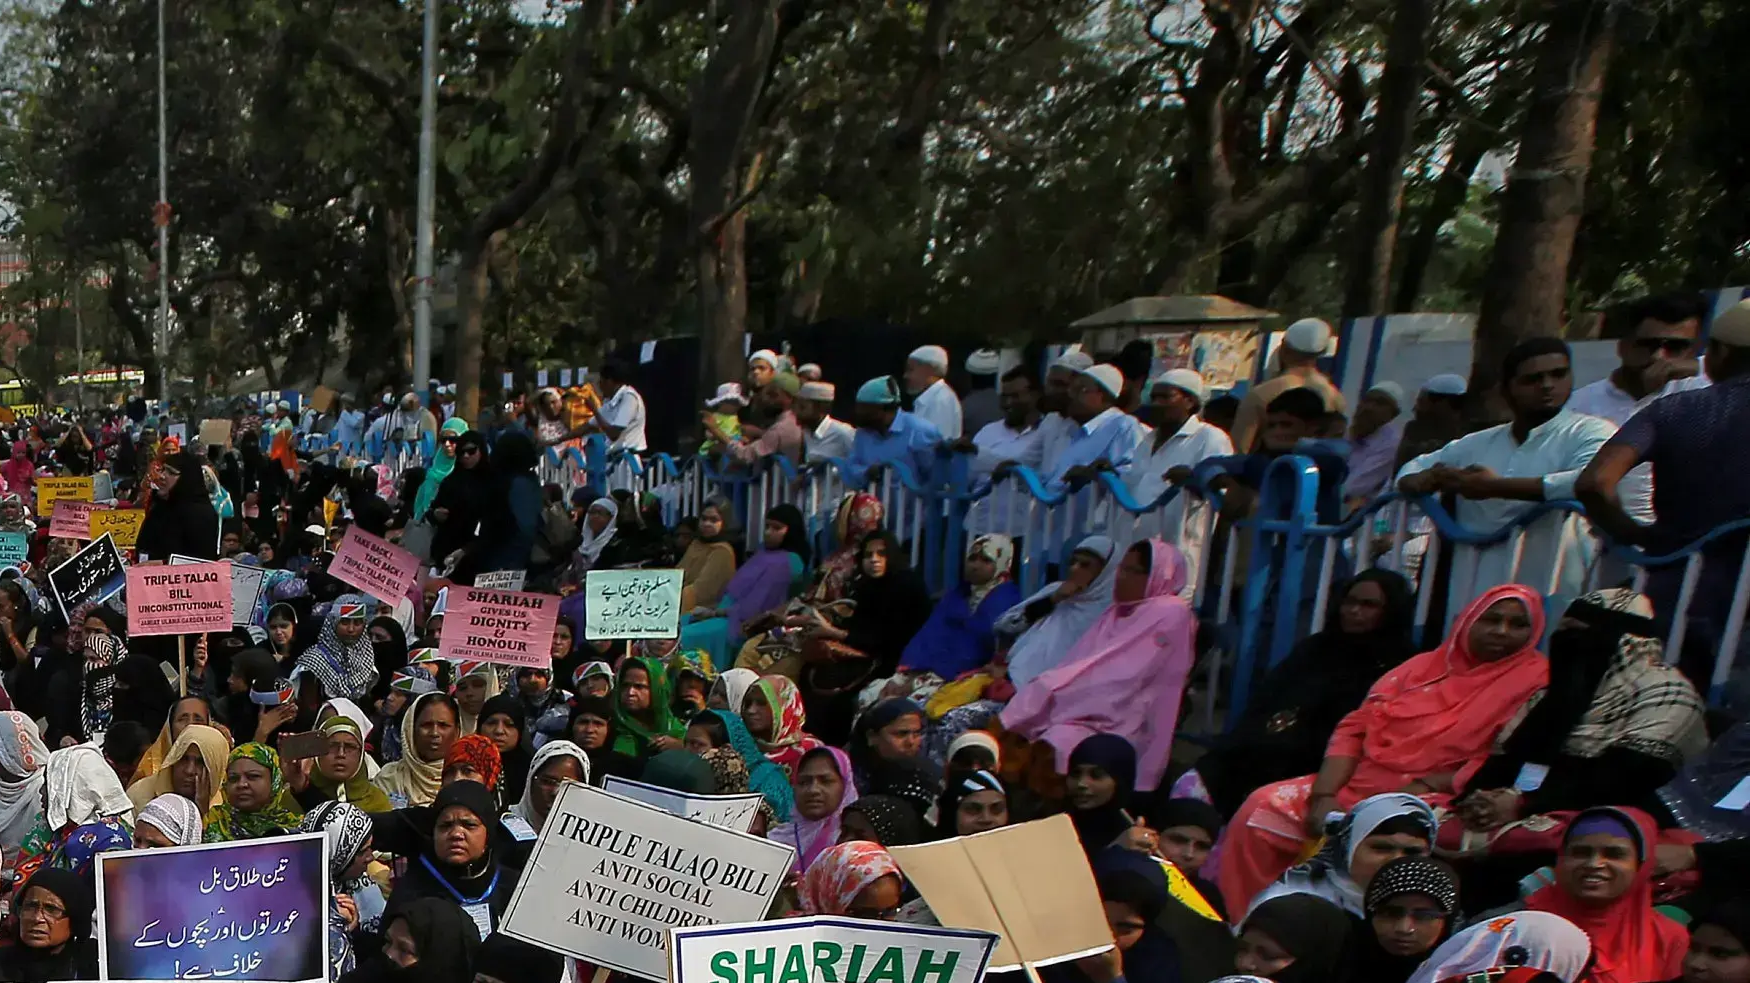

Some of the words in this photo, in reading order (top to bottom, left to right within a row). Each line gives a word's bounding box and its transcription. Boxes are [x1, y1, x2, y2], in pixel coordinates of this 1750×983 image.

[353, 534, 371, 551] TAKE
[364, 553, 382, 568] TAKE
[144, 575, 180, 585] TRIPLE
[182, 573, 218, 584] TALAQ
[365, 567, 387, 585] TALAQ
[386, 579, 400, 591] BILL
[478, 575, 497, 583] TRIPLE
[647, 576, 670, 601] مسلم
[138, 600, 223, 613] UNCONSTITUTIONAL
[169, 589, 193, 600] BILL
[466, 591, 544, 610] SHARIAH
[470, 616, 531, 631] DIGNITY
[480, 606, 510, 616] GIVES
[513, 610, 527, 618] US
[466, 636, 527, 652] HONOUR
[493, 627, 505, 638] &
[557, 811, 643, 859] TRIPLE
[643, 839, 720, 886] TALAQ
[719, 862, 770, 897] BILL
[199, 866, 222, 893] بل
[223, 866, 260, 891] طلاق
[260, 858, 289, 888] تین
[591, 858, 645, 885] ANTI
[643, 872, 715, 908] SOCIAL
[565, 878, 619, 907] ANTI
[133, 919, 164, 947] کے
[237, 910, 300, 941] عورتوں
[566, 907, 619, 935] ANTI
[209, 951, 263, 976] خلاف
